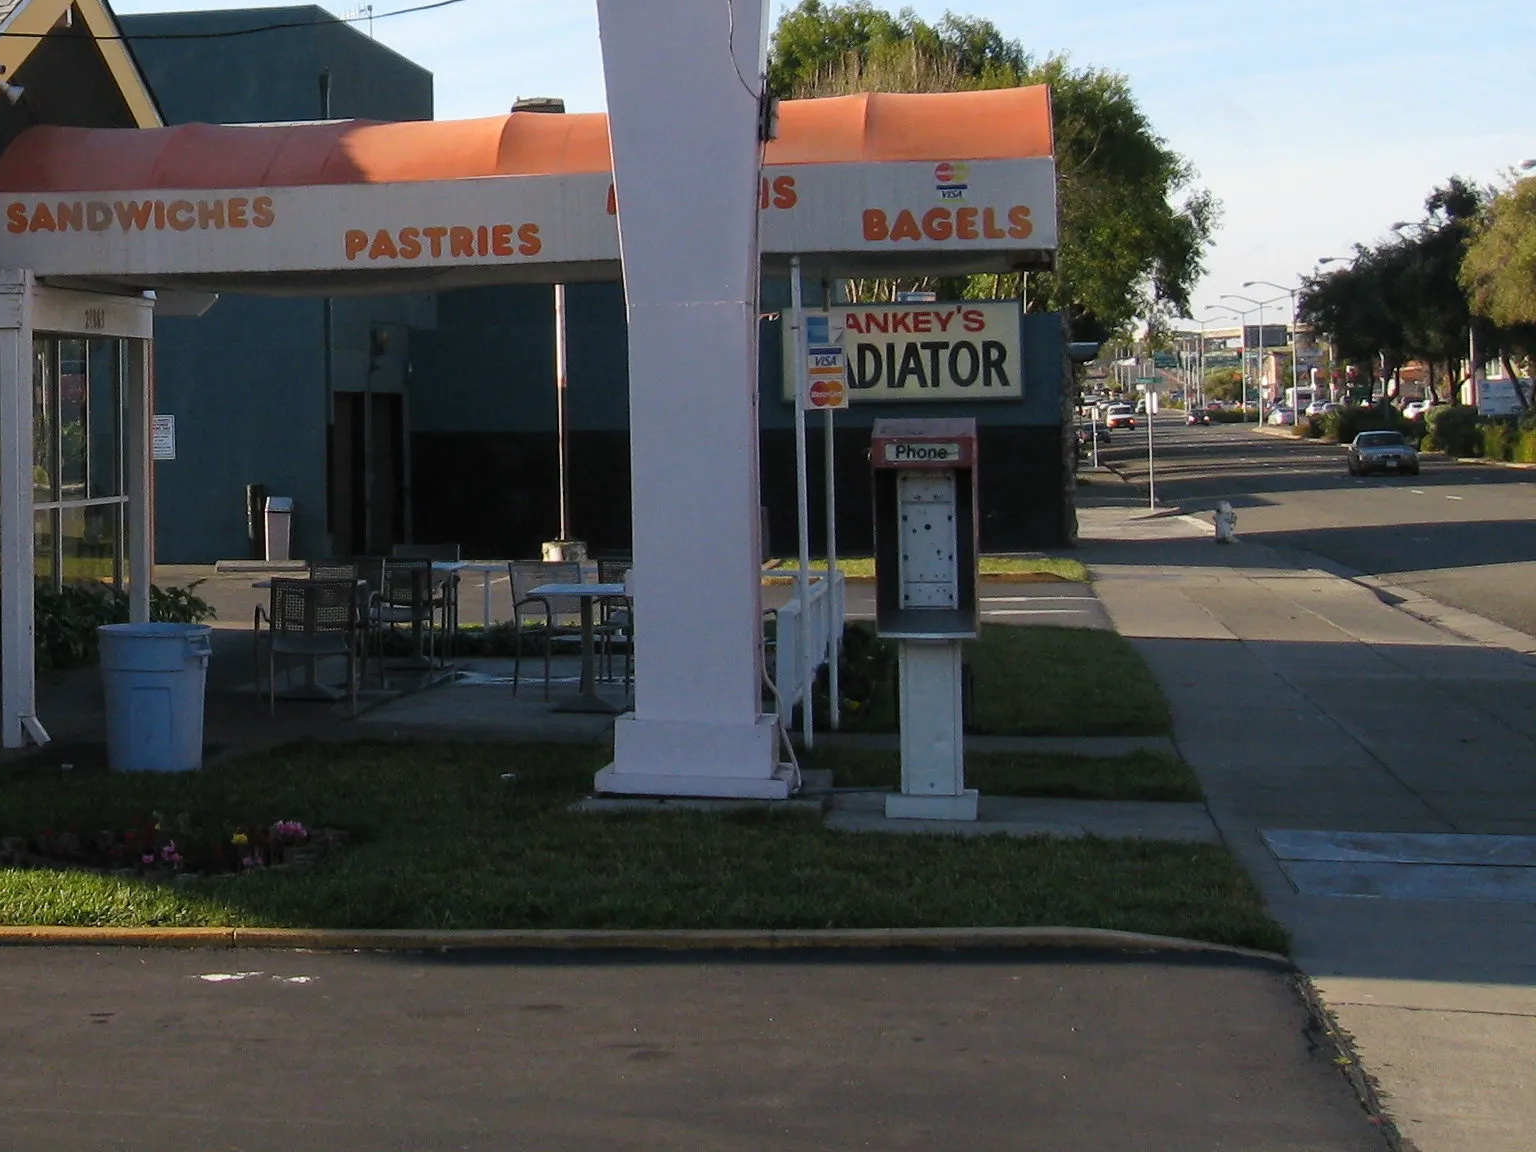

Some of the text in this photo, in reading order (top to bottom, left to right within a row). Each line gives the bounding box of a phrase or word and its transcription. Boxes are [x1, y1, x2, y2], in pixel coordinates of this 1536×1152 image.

[6, 196, 275, 234] SANDWICHES
[862, 205, 1033, 242] BAGELS
[344, 223, 542, 261] PASTRIES
[846, 305, 986, 334] ANKEY'S
[814, 355, 837, 367] VISA
[847, 340, 1011, 389] DIATOR
[895, 444, 948, 460] Phone
